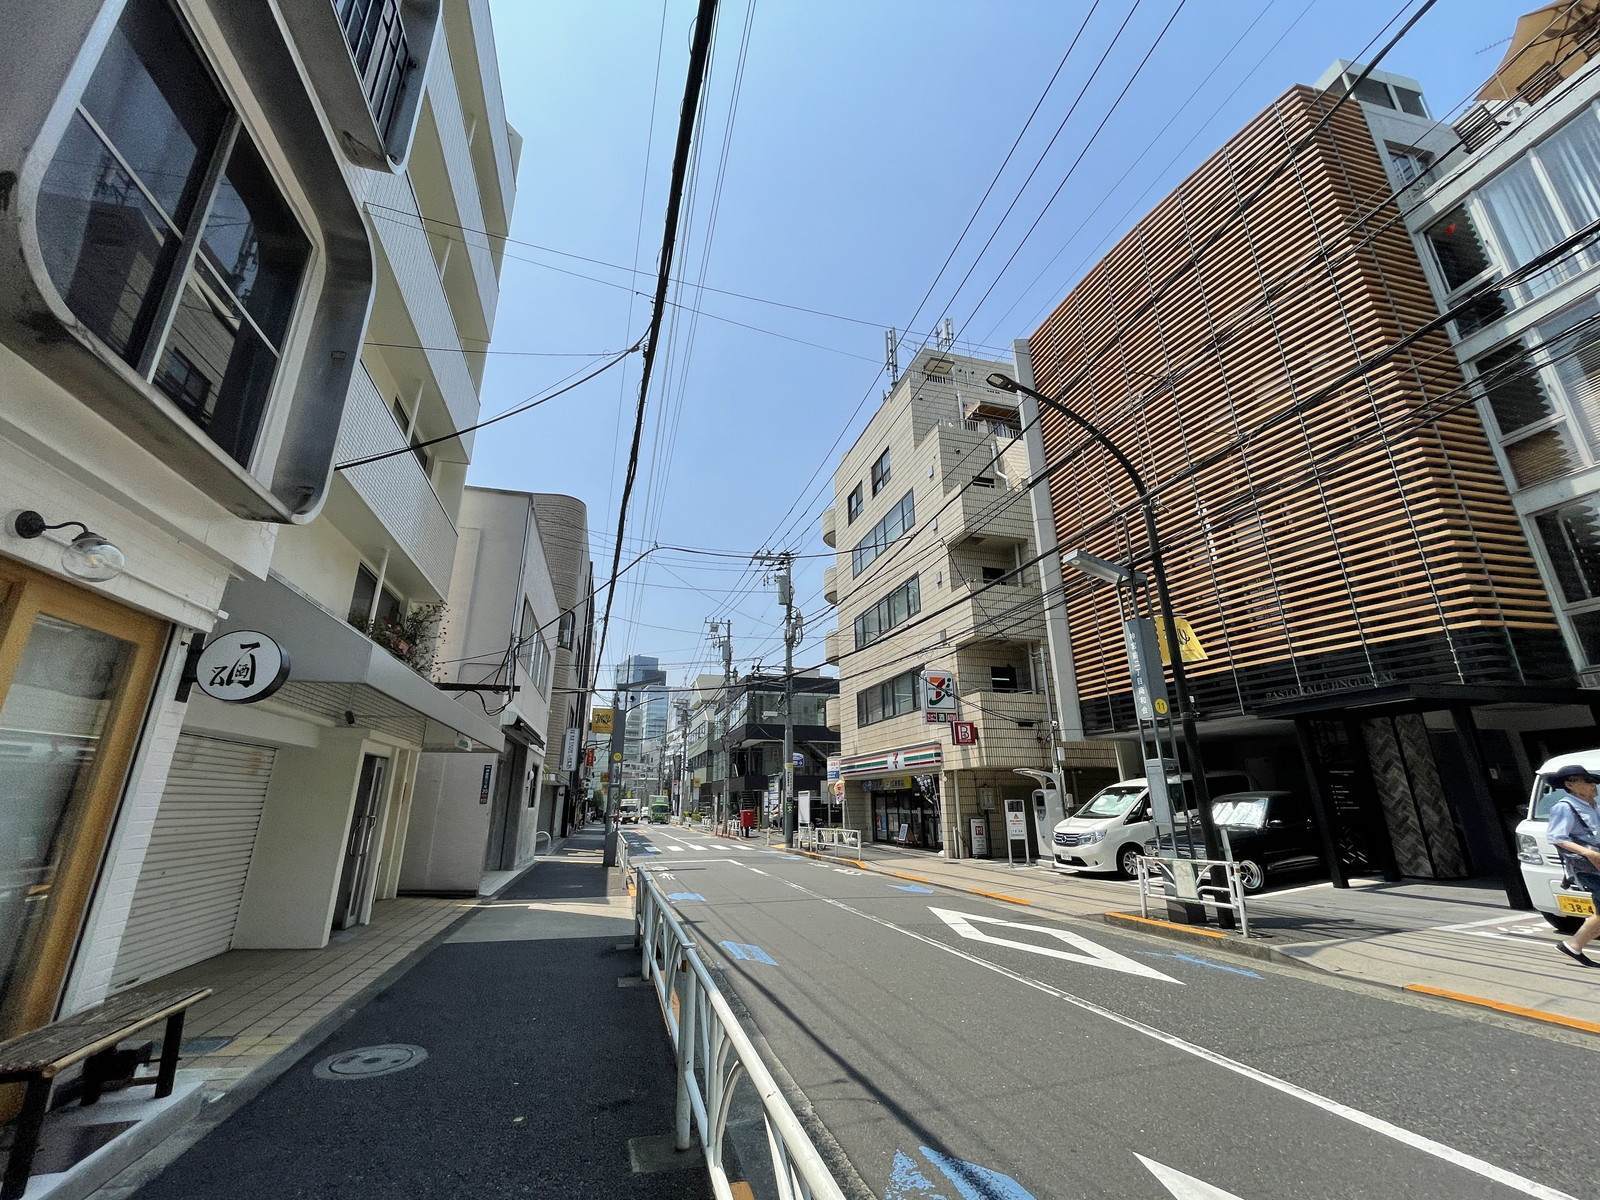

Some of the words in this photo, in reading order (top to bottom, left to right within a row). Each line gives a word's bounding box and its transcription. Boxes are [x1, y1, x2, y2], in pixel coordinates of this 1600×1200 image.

[1265, 683, 1331, 701] PASTORALE
[1330, 671, 1398, 692] JINGUMAE
[1156, 701, 1166, 710] 11
[1568, 903, 1595, 914] 38-4
